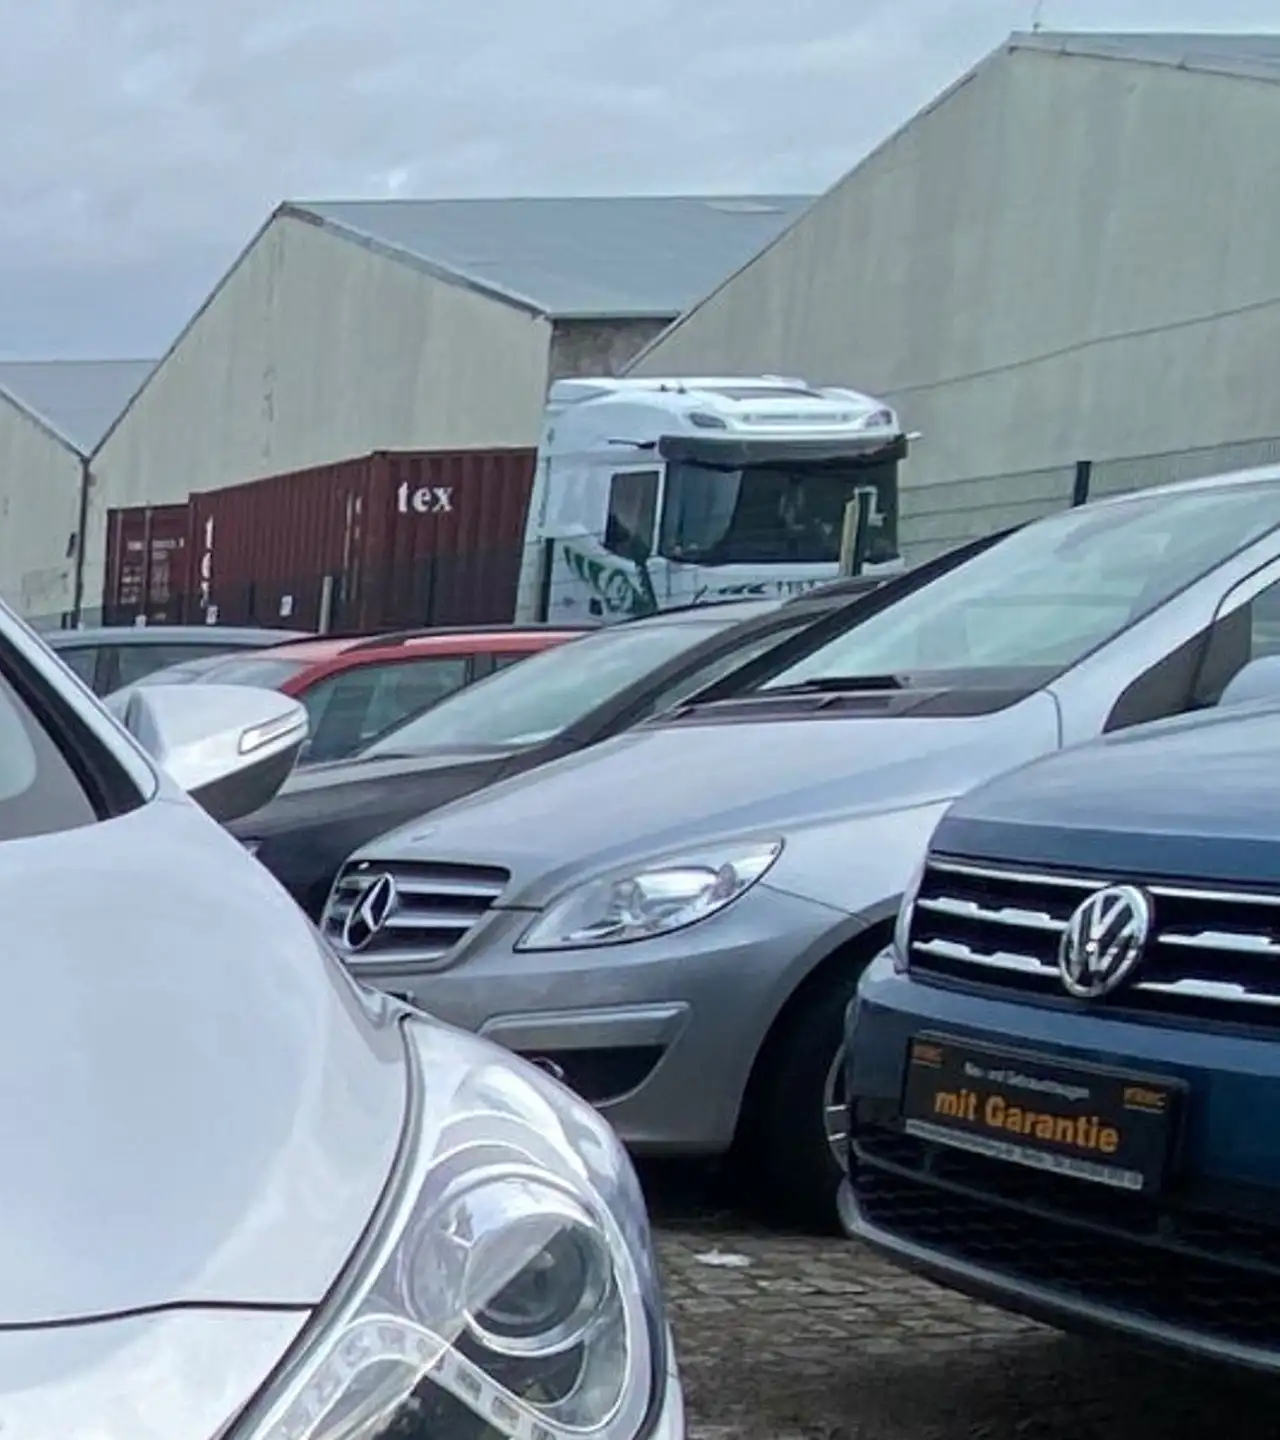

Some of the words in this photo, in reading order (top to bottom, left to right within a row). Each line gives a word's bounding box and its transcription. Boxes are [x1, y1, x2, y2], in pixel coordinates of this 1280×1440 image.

[397, 482, 453, 513] tex
[934, 1088, 978, 1120] mit
[984, 1094, 1120, 1154] Garantie
